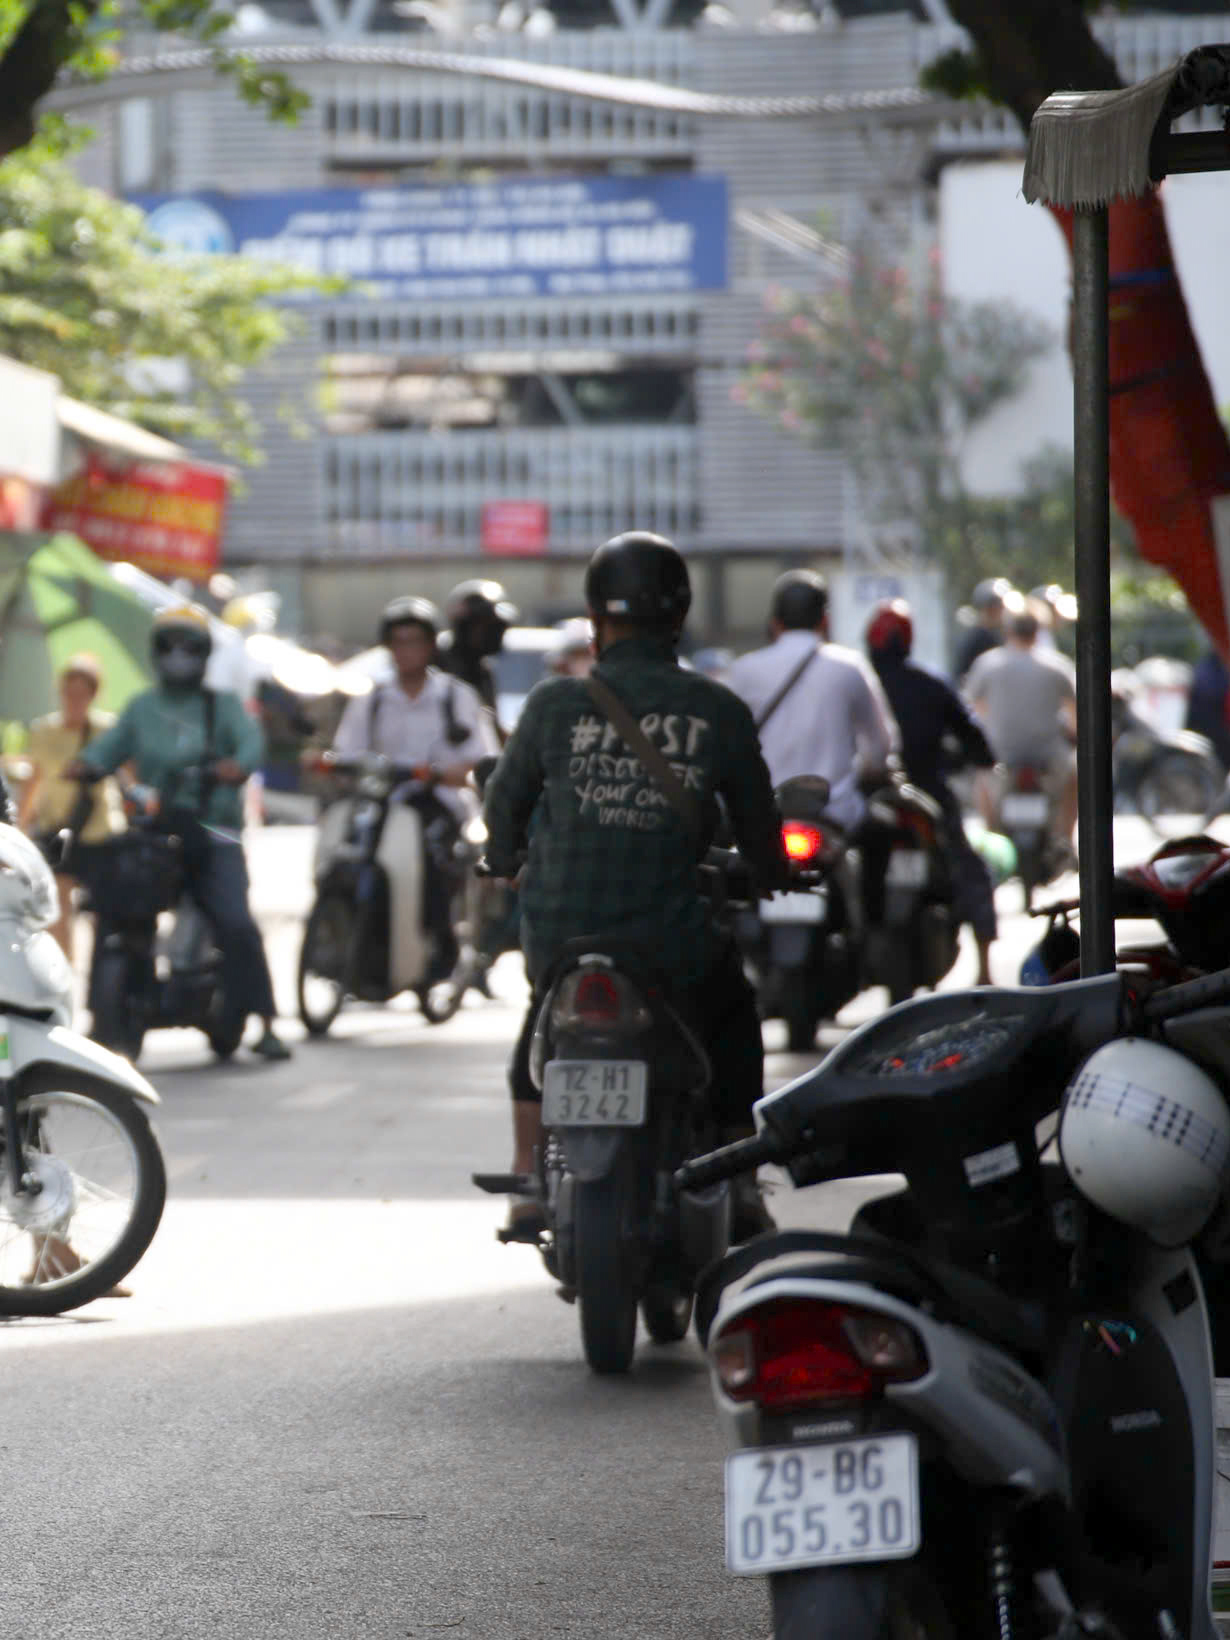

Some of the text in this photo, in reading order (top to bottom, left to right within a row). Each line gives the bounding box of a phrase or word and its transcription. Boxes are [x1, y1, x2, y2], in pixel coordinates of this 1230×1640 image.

[574, 780, 636, 815] your
[559, 1094, 630, 1120] 3242
[754, 1442, 884, 1505] 29-BG
[741, 1498, 903, 1560] 055.30
